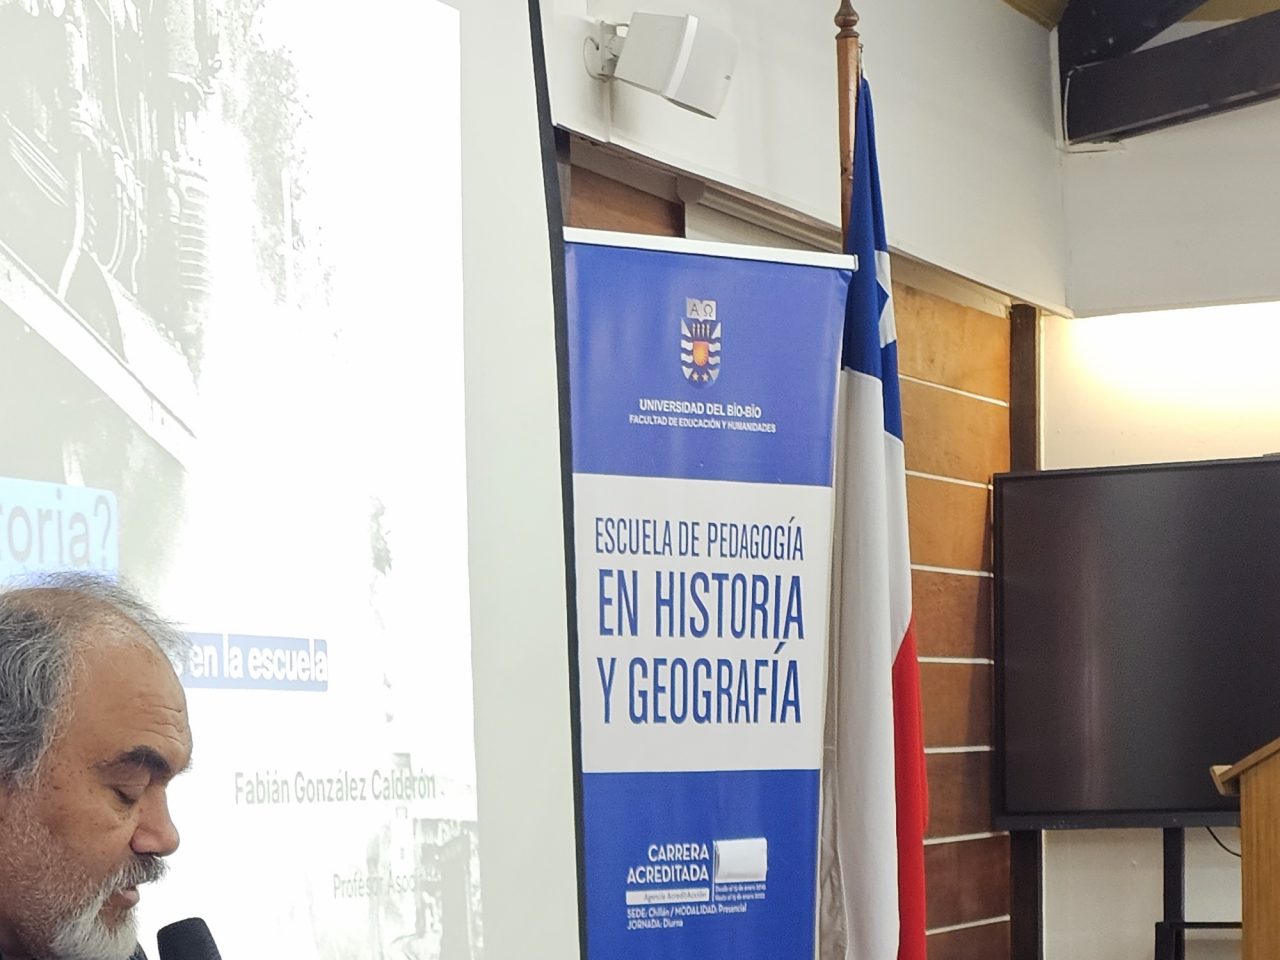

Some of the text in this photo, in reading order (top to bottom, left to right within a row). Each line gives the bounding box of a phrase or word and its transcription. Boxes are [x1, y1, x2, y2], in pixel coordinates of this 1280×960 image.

[639, 398, 704, 415] UNIVERSIDAD
[707, 402, 725, 417] DEL
[629, 414, 668, 426] FACULTAD
[668, 416, 679, 426] DE
[679, 416, 720, 429] EDUCACIÓN
[727, 420, 776, 433] HUMANIDADES
[595, 516, 804, 561] ESCUELA DE PEDAGOGÍA
[598, 568, 805, 640] EN HISTORIA
[189, 644, 218, 679] en
[223, 631, 244, 680] la
[248, 636, 329, 683] escuela
[596, 641, 802, 725] Y GEOGRAFÍA
[234, 767, 437, 805] Fabián González Calderón
[647, 843, 710, 862] CARRERA
[626, 864, 709, 885] ACREDITADA
[626, 908, 648, 919] SEDE:
